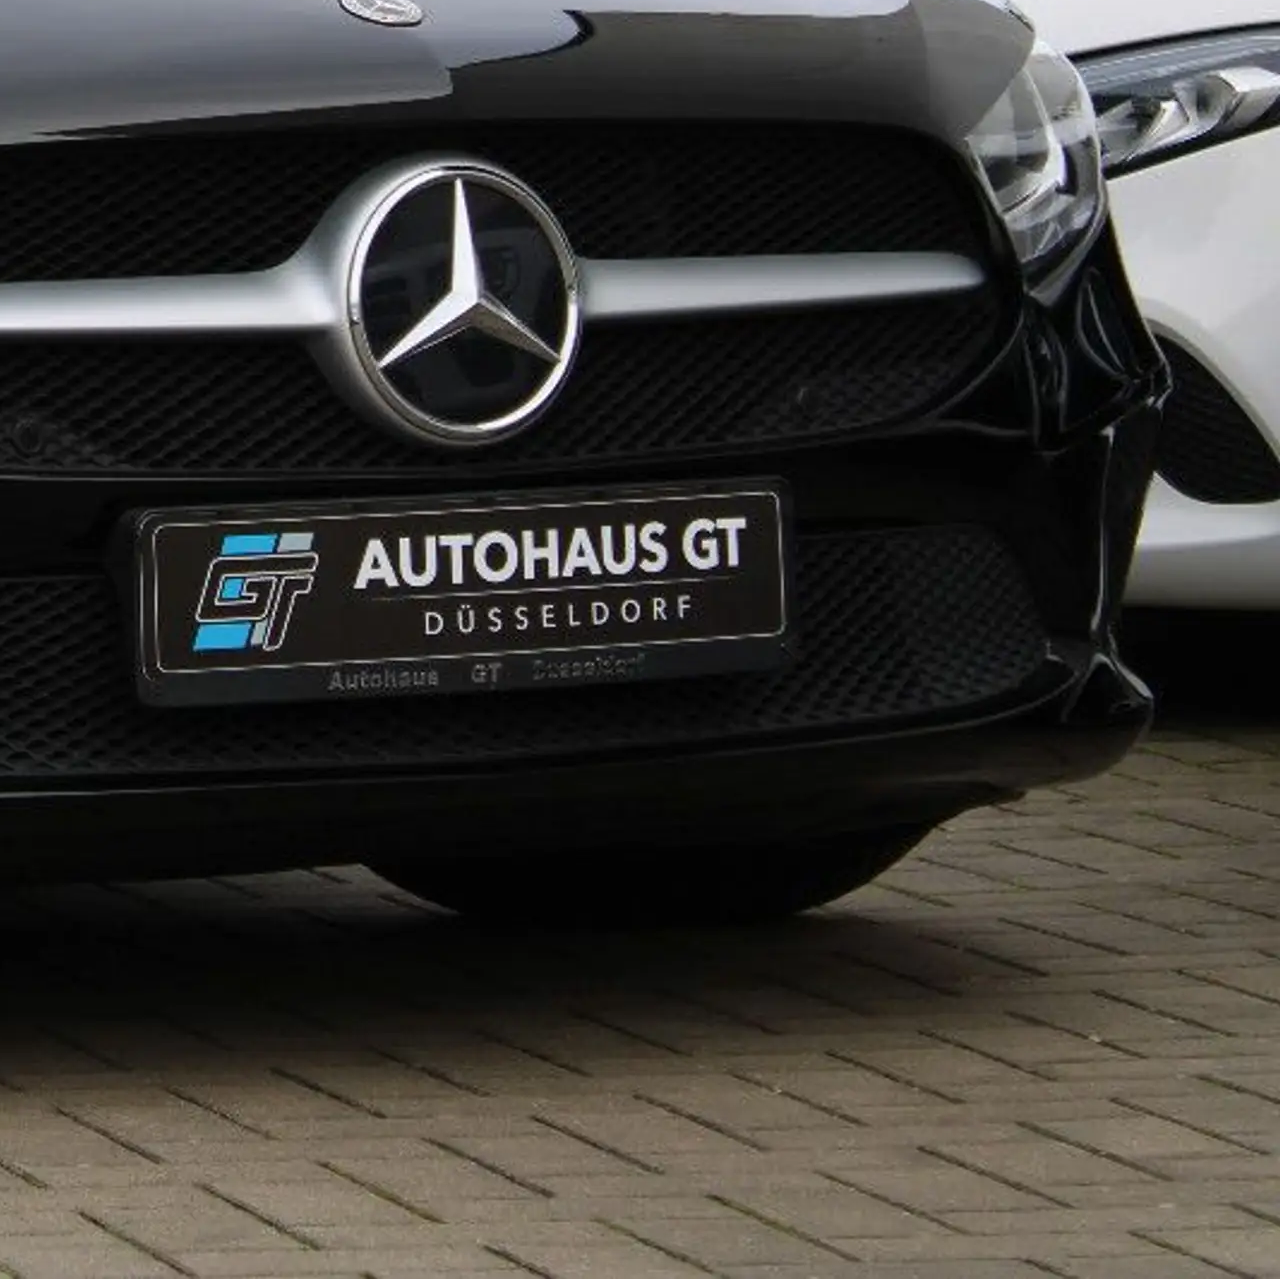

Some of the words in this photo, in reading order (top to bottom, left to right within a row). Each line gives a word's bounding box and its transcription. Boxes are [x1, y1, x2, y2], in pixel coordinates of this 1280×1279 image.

[354, 521, 667, 590] AUTOHAUS
[681, 517, 747, 571] GT
[424, 594, 692, 637] DÜSSELDORF
[328, 664, 439, 692] Autohaus
[470, 660, 503, 685] GT
